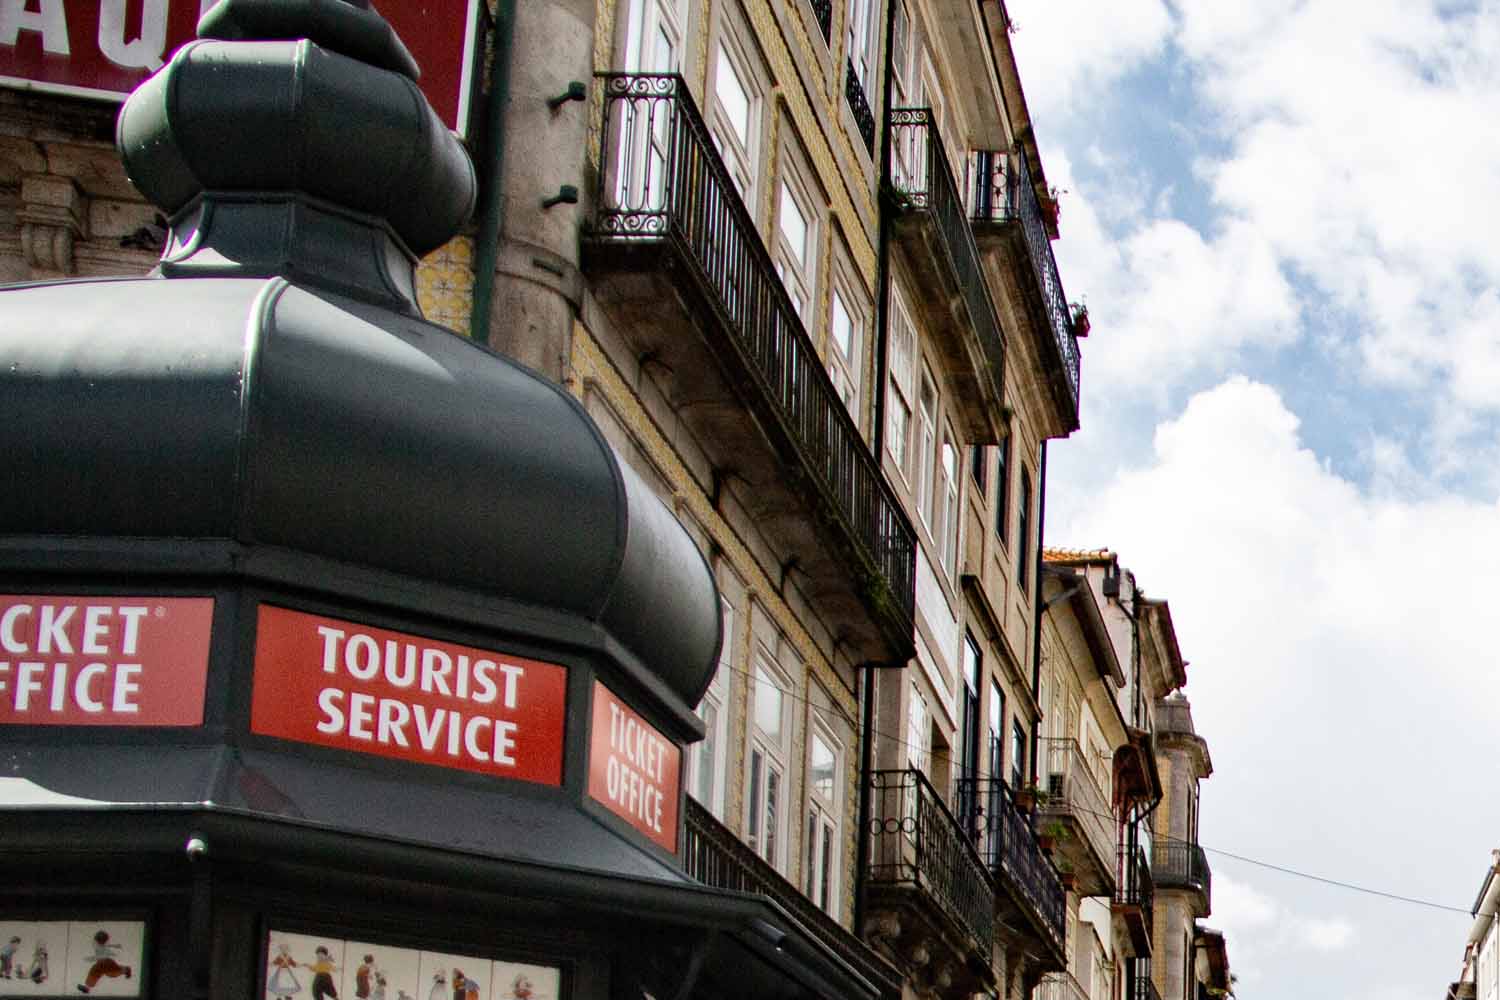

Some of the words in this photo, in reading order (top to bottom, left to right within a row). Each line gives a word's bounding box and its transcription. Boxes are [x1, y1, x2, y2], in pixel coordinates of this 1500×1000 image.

[317, 625, 524, 709] TOURIST
[315, 687, 519, 767] SERVICE
[608, 702, 665, 785] TICKET
[606, 755, 662, 833] OFFICE
